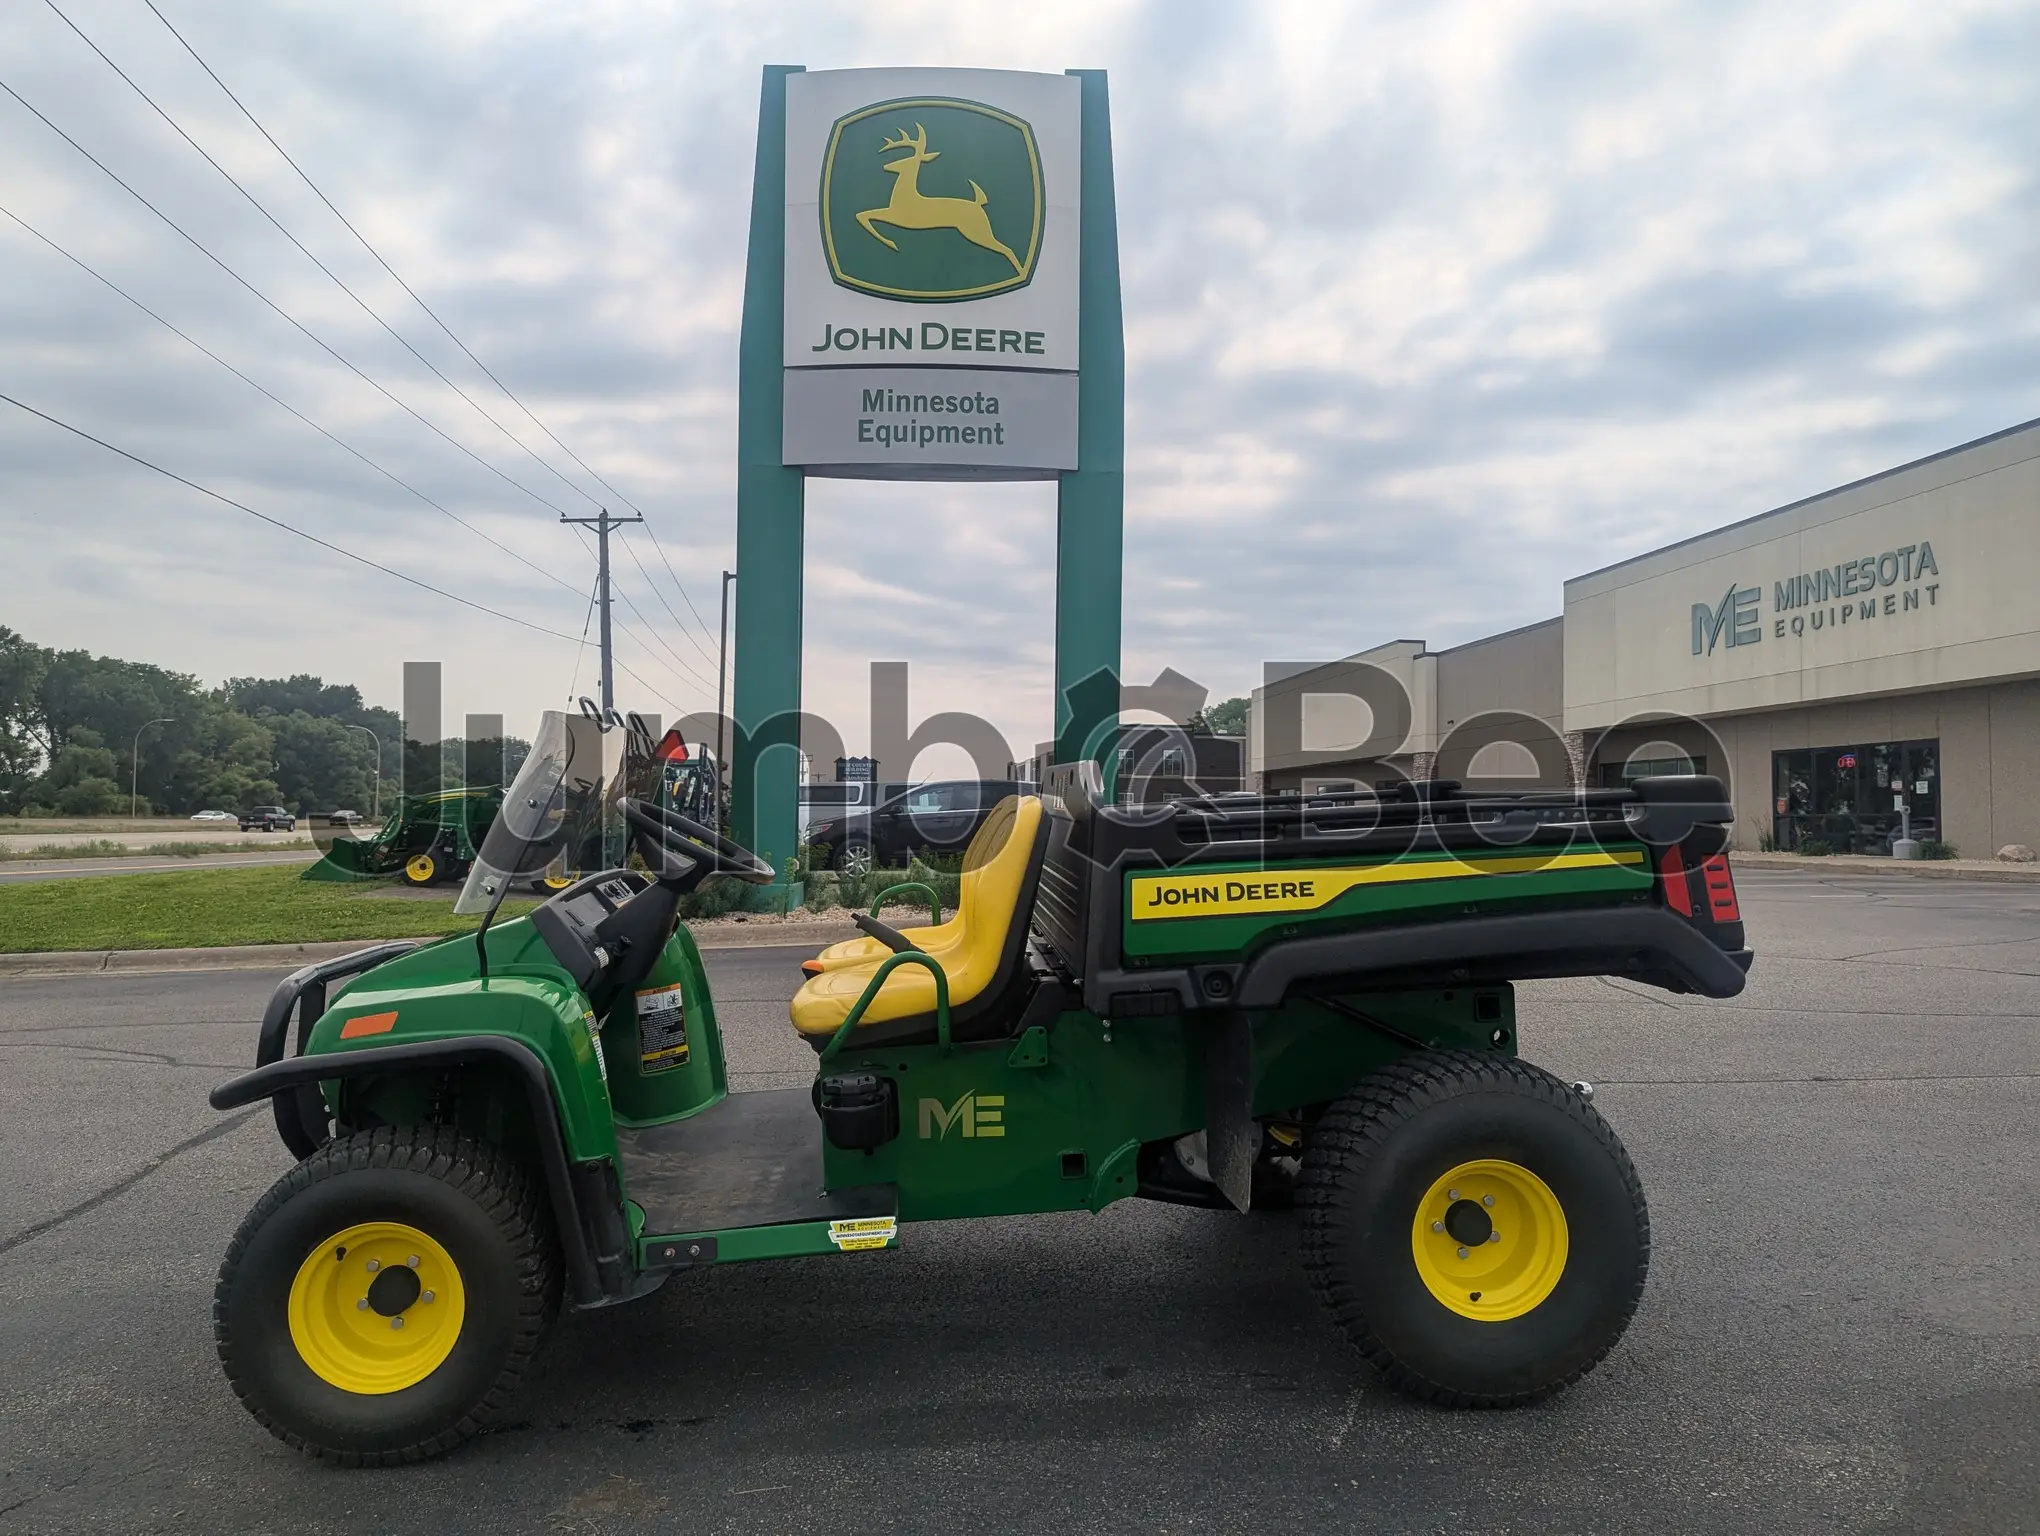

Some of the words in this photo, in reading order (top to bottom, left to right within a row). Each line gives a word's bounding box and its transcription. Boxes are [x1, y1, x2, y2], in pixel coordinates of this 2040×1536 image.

[812, 323, 913, 352] JOHN
[920, 322, 1046, 355] DEERE
[862, 388, 1000, 415] Minnesota
[857, 418, 1004, 448] Equipment
[1773, 541, 1939, 613] MINNESOTA
[1774, 584, 1939, 638] EQUIPMENT
[1837, 757, 1856, 768] OPEN
[1148, 886, 1219, 907] JOHN
[1226, 881, 1315, 902] DEERE
[918, 1088, 1005, 1142] ME
